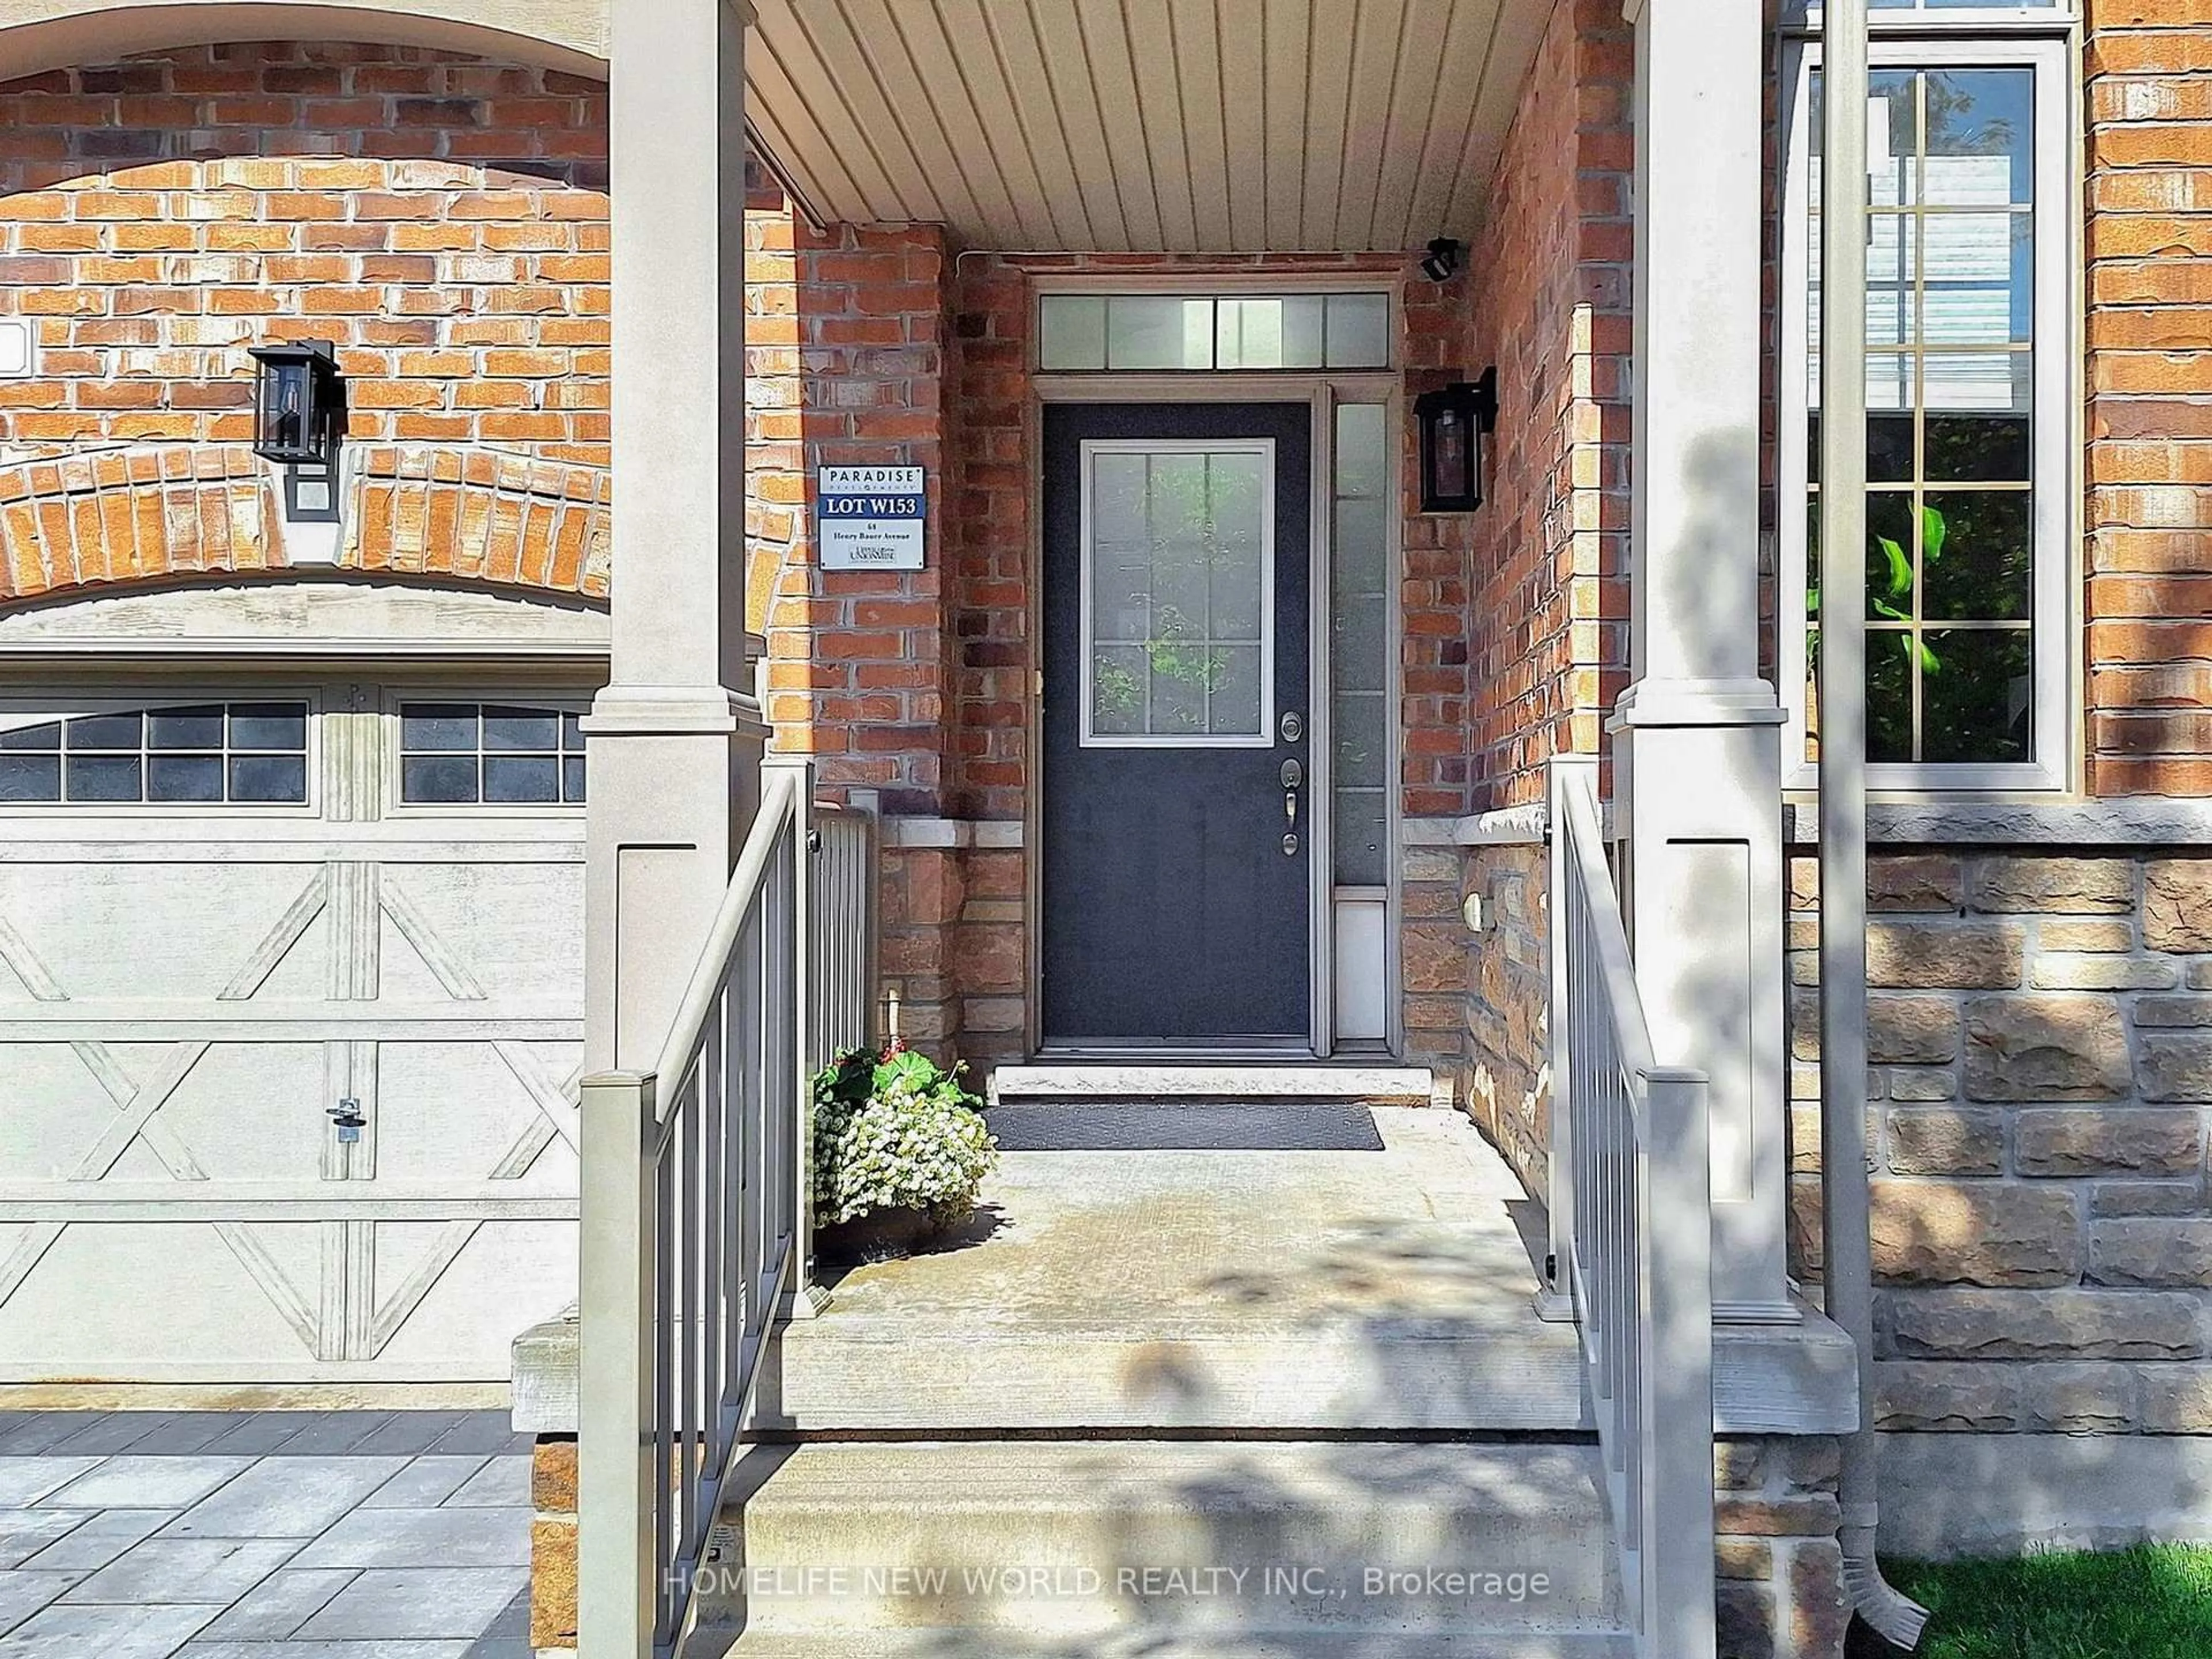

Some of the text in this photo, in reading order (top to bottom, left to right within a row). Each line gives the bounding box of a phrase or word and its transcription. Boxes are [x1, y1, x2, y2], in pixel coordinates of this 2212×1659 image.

[830, 471, 913, 481] PARADISE
[827, 499, 915, 513] LOT W153
[834, 532, 857, 540] Henry
